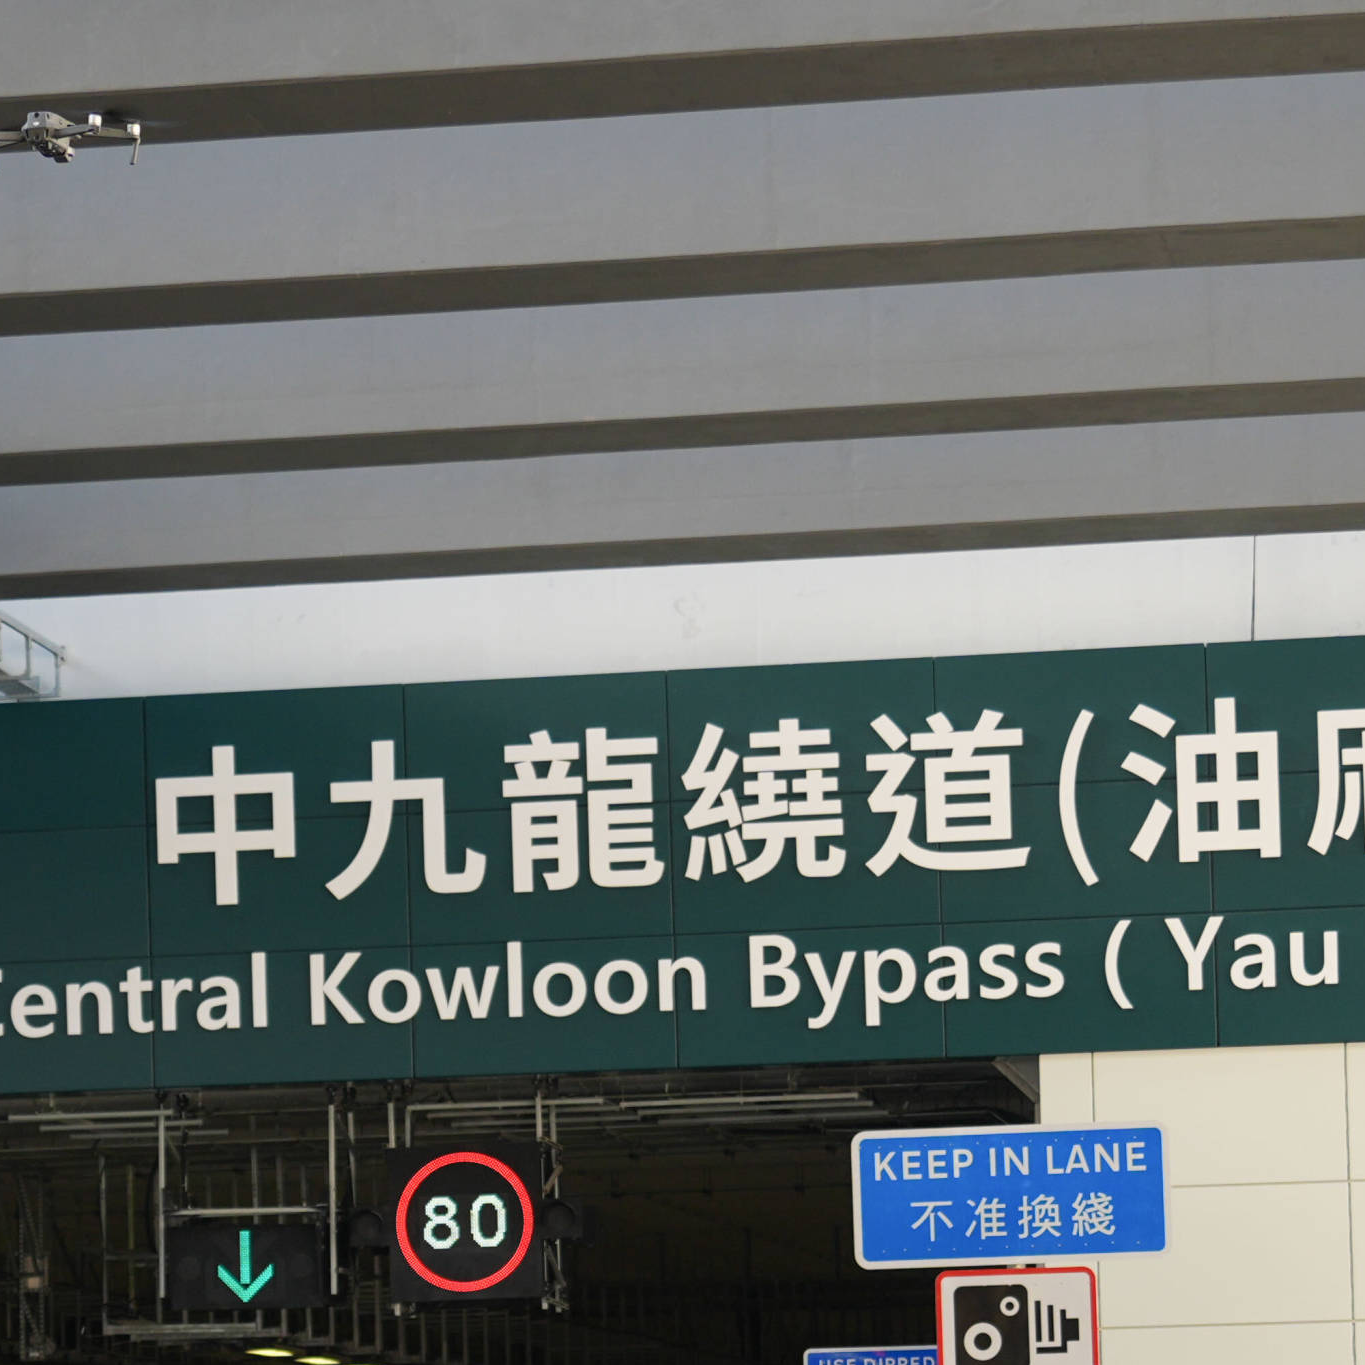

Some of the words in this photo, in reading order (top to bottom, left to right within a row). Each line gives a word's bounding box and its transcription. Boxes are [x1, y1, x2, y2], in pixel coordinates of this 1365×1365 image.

[309, 940, 707, 1026] Kowloon
[748, 933, 1065, 1031] Bypass
[1164, 915, 1340, 991] Yau
[874, 1149, 973, 1181] KEEP
[989, 1146, 1030, 1177] IN
[1046, 1141, 1147, 1174] LANE
[423, 1194, 507, 1249] 80
[910, 1192, 1116, 1242] 不准換綫
